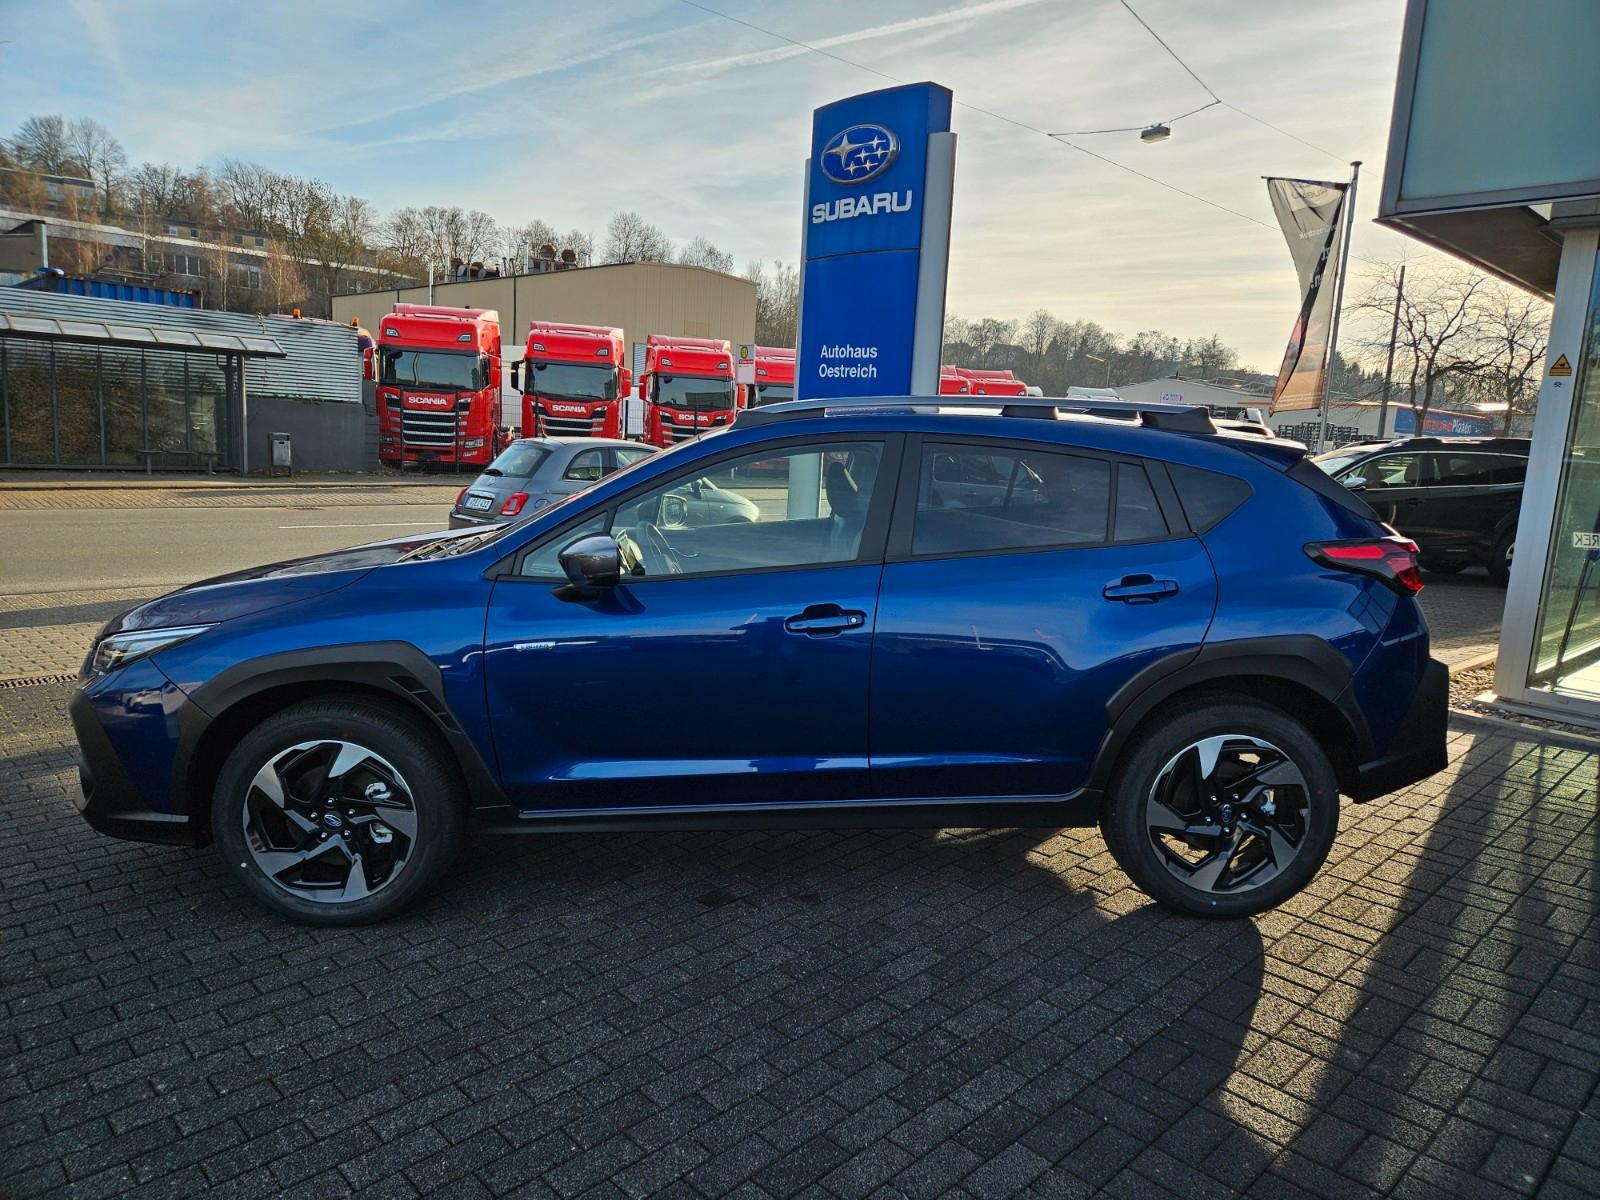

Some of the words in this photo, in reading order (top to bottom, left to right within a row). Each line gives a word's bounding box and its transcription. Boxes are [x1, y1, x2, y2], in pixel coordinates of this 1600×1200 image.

[812, 190, 913, 224] SUBARU
[820, 344, 878, 359] Autohaus
[818, 363, 877, 378] Oestreich
[408, 396, 448, 406] SCANIA
[552, 404, 587, 413] SCANIA
